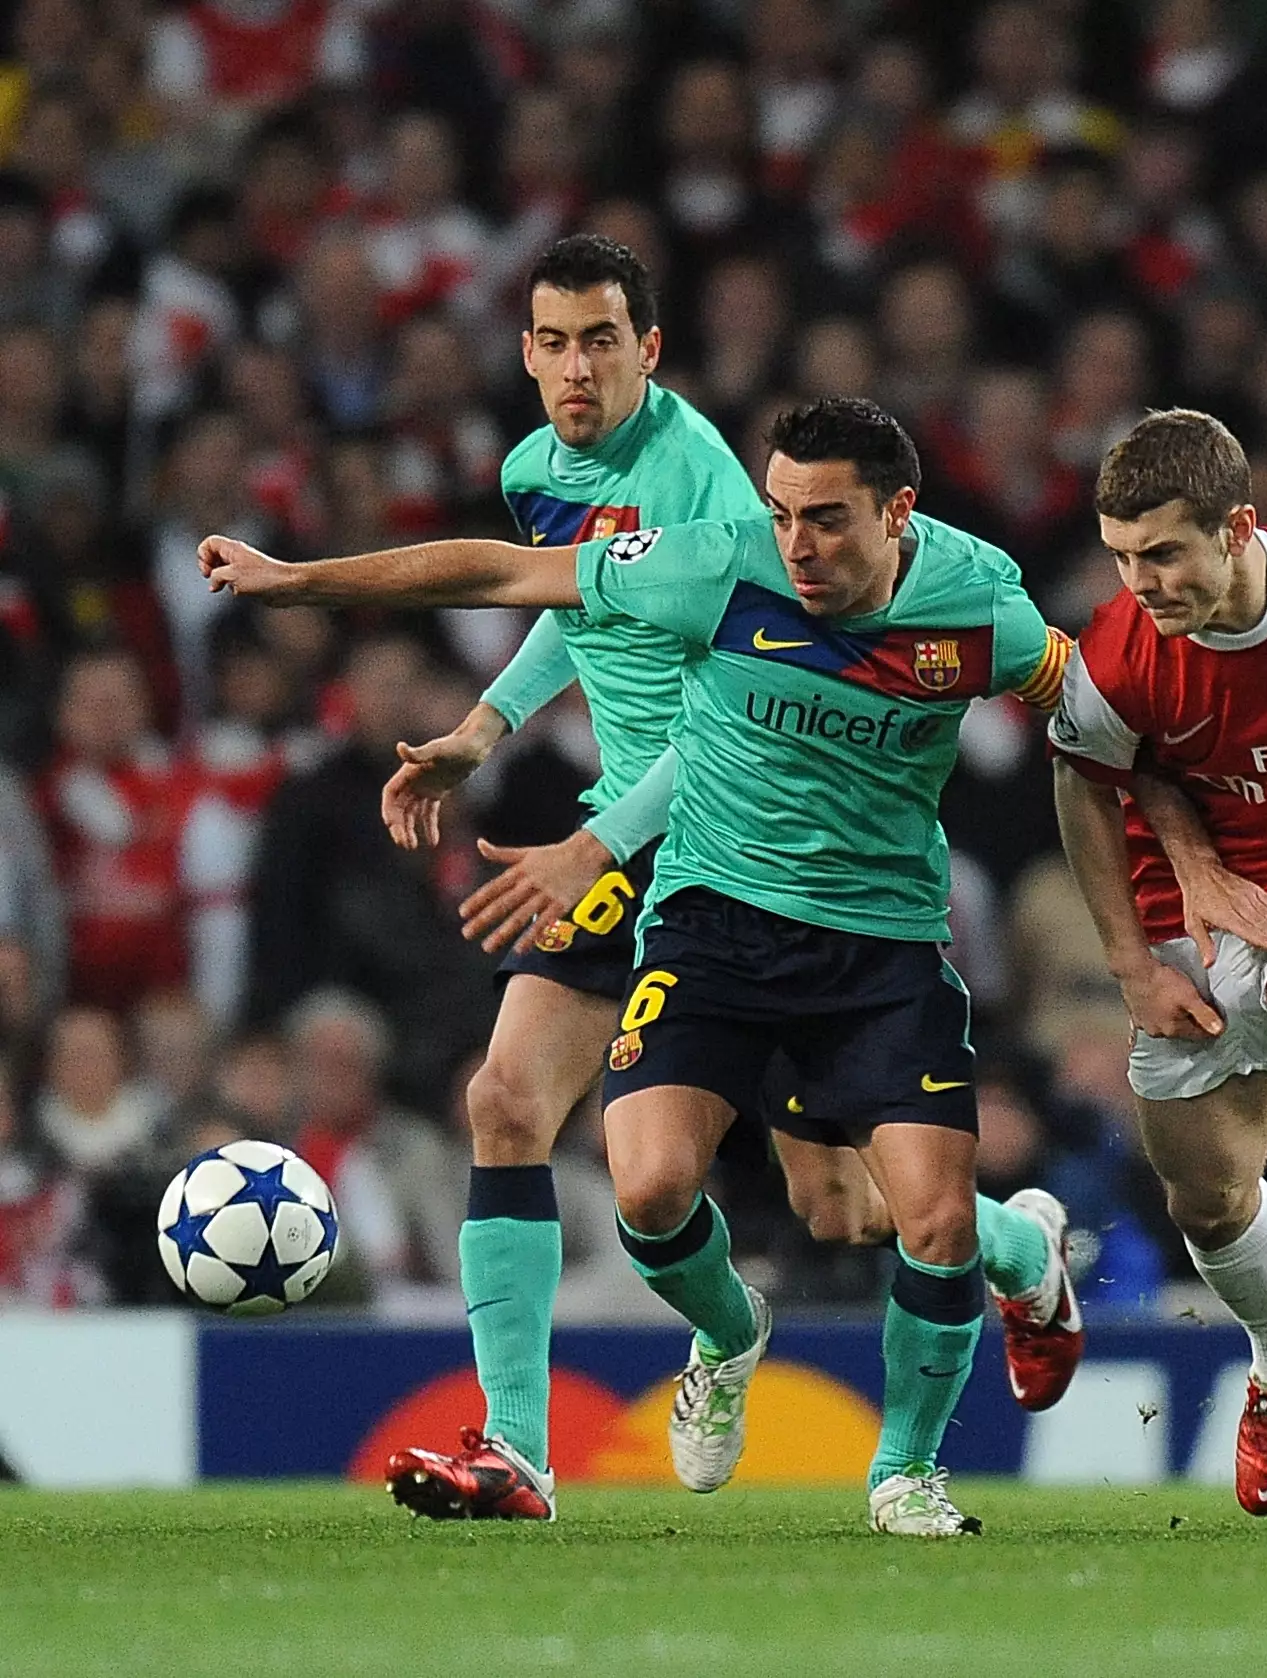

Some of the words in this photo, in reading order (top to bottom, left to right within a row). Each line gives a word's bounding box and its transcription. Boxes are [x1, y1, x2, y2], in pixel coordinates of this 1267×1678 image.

[746, 692, 900, 749] unicef
[572, 871, 636, 935] 6
[621, 970, 679, 1032] 6
